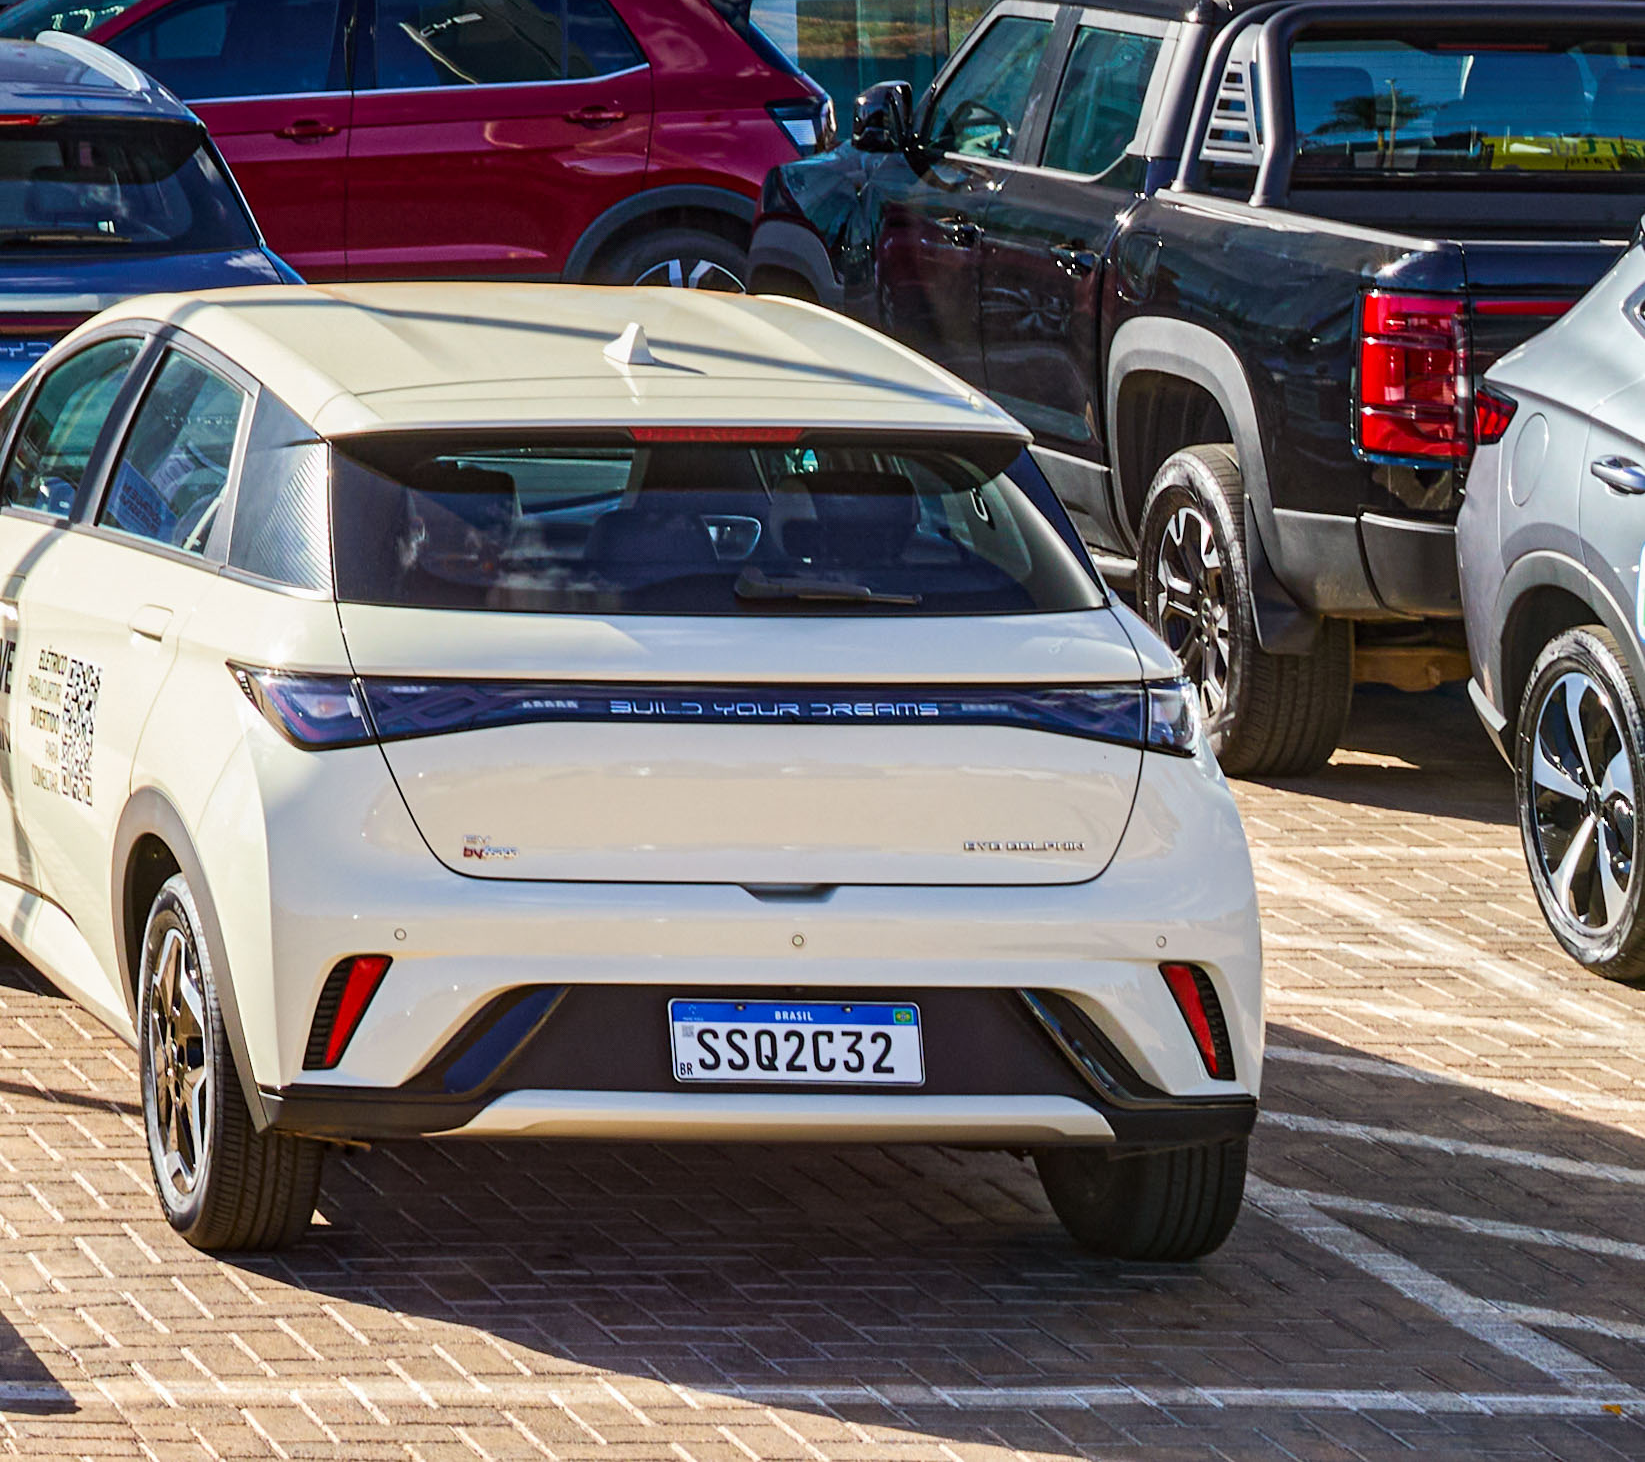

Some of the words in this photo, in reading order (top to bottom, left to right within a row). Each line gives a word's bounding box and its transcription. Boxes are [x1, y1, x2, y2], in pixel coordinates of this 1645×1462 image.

[610, 700, 703, 715] BUILD
[714, 702, 801, 717] YOUR
[810, 702, 940, 717] DREAMS
[963, 841, 1003, 852] BYD
[1006, 841, 1085, 852] DOLPHIN
[774, 1010, 814, 1022] BRASIL
[696, 1028, 895, 1074] SSQ2C32
[680, 1062, 694, 1076] BR
